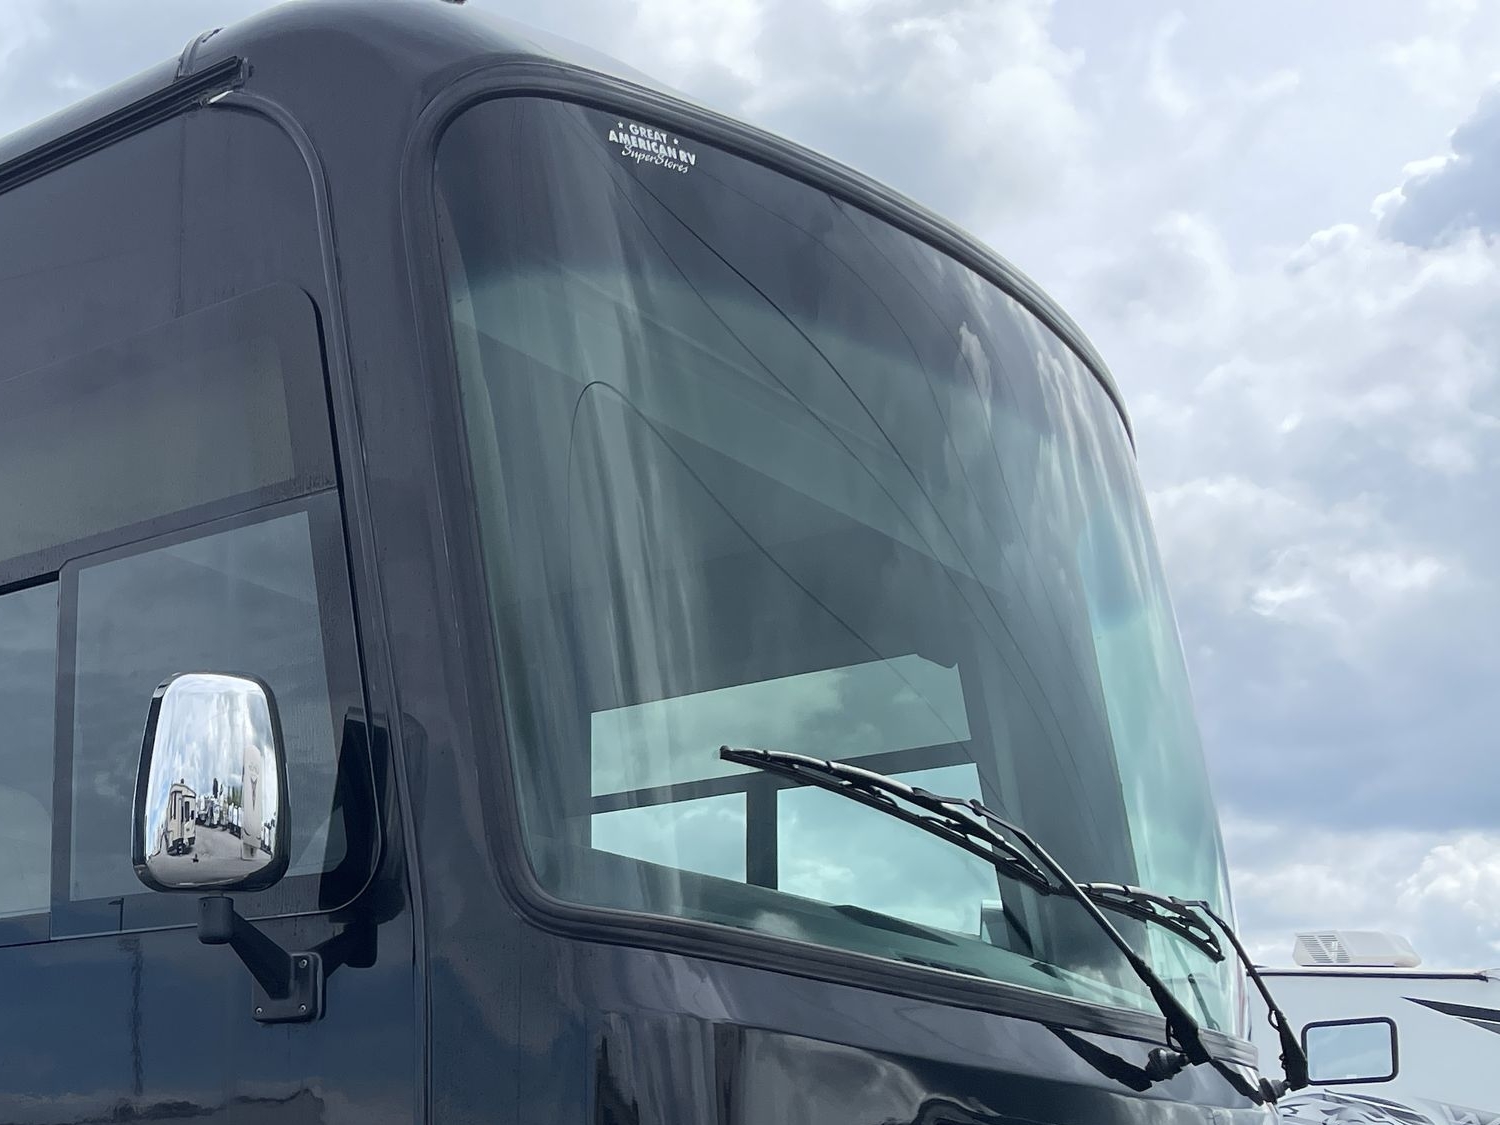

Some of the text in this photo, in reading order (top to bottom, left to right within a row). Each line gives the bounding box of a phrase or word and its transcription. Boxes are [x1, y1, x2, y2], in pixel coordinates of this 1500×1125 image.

[629, 123, 667, 144] GREAT
[608, 130, 696, 166] AMERICAN RV
